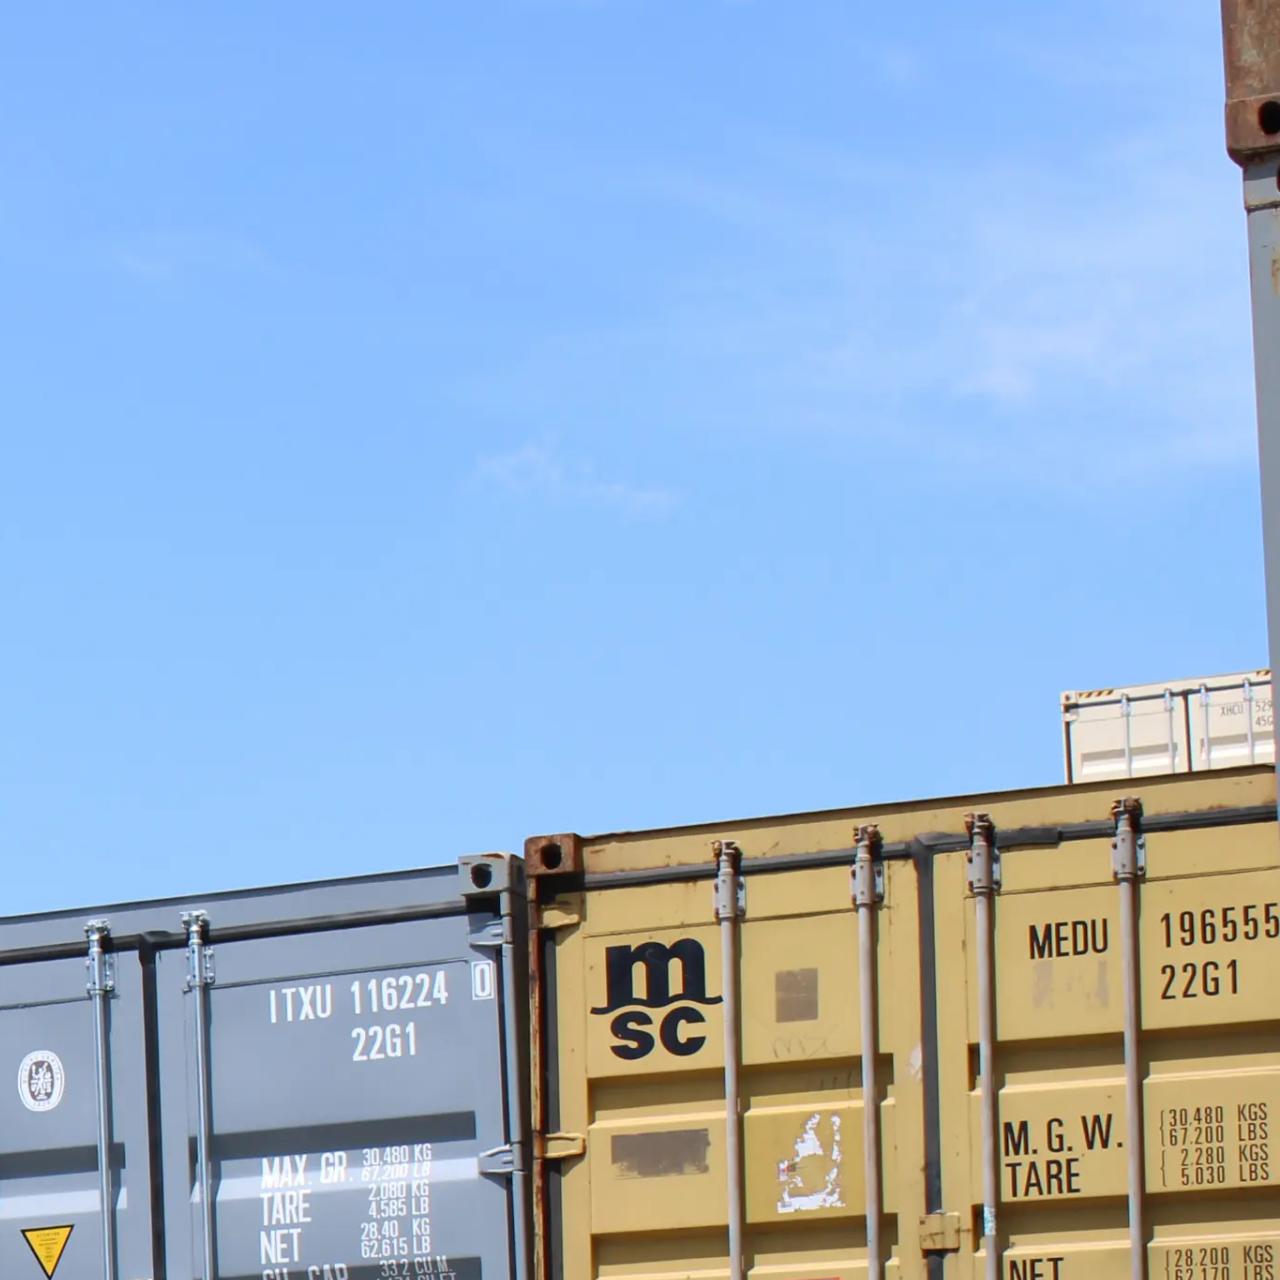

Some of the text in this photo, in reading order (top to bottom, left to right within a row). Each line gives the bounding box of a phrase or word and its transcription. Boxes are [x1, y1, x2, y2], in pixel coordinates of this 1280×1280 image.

[1028, 902, 1280, 959] MEDU 196555
[1160, 959, 1238, 1000] 22G1
[268, 962, 493, 1023] ITXU 116224 0
[351, 1022, 416, 1061] 22G1
[1237, 1102, 1268, 1122] KGS
[1003, 1113, 1124, 1157] M. G. W.
[1238, 1122, 1269, 1141] LBS
[414, 1143, 432, 1162] KG
[1239, 1143, 1269, 1162] KGS
[320, 1151, 354, 1185] GR.
[413, 1160, 431, 1178] LB
[1005, 1158, 1081, 1198] TARE
[1239, 1162, 1270, 1182] LBS
[411, 1179, 430, 1197] KG
[259, 1189, 312, 1226] TARE
[411, 1197, 429, 1216] LB
[412, 1217, 431, 1236] KG
[260, 1228, 302, 1265] NET
[412, 1236, 431, 1254] LB
[1243, 1245, 1273, 1264] KGS
